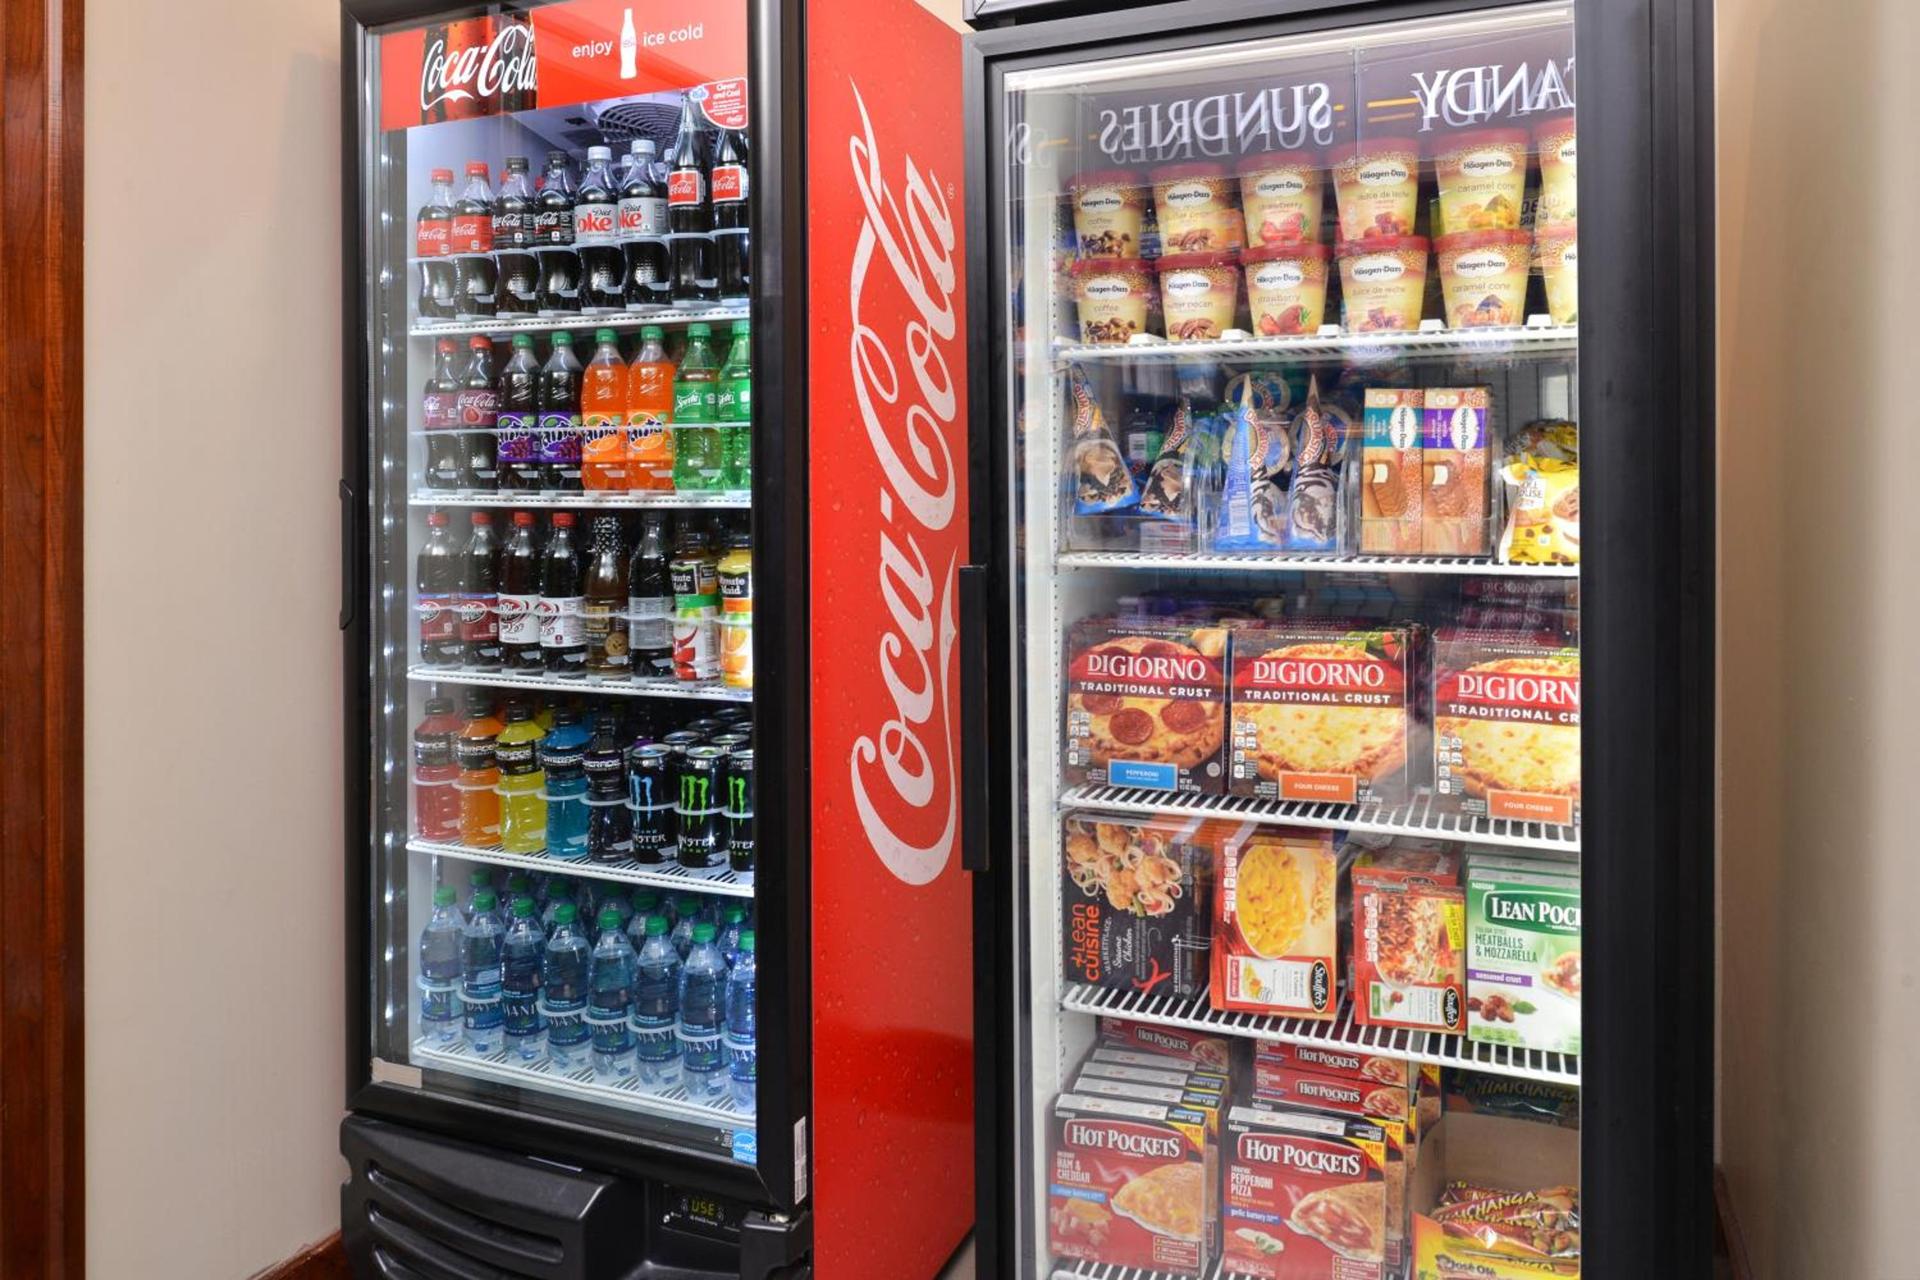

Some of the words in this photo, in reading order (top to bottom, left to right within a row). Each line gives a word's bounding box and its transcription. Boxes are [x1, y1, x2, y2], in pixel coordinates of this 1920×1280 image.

[643, 29, 665, 47] ice
[668, 25, 703, 43] cold
[572, 41, 613, 58] enjoy
[421, 24, 538, 111] Coca-Cola
[577, 213, 613, 233] oke
[850, 78, 957, 886] Coca-Cola
[1087, 654, 1207, 681] DIGIORNO
[1253, 661, 1384, 687] DIGIORNO
[1080, 681, 1165, 696] TRADITIONAL
[1168, 686, 1212, 698] CRUST
[1245, 690, 1339, 703] TRADITIONAL
[1344, 693, 1391, 705] CRUST
[1458, 674, 1579, 705] DIGIORN
[1449, 703, 1553, 722] TRADITIONAL
[1558, 710, 1579, 724] CR
[1491, 897, 1536, 922] LEAN
[1086, 904, 1099, 981] cuisine
[1475, 933, 1524, 949] MEATBALLS
[1484, 947, 1538, 963] MOZZARELLA
[1154, 1032, 1189, 1050] POCKETS
[1300, 1049, 1319, 1061] HOT
[1319, 1052, 1360, 1069] POCKETS
[1300, 1082, 1319, 1095] HOT
[1319, 1085, 1361, 1103] POCKETS
[1071, 1124, 1106, 1148] HOT
[1107, 1129, 1181, 1158] POCKETS
[1245, 1138, 1281, 1163] HOT
[1283, 1144, 1362, 1176] POCKETS
[1231, 1172, 1274, 1190] PEPPERONI
[1231, 1184, 1252, 1197] PIZZA
[691, 1199, 716, 1216] USE
